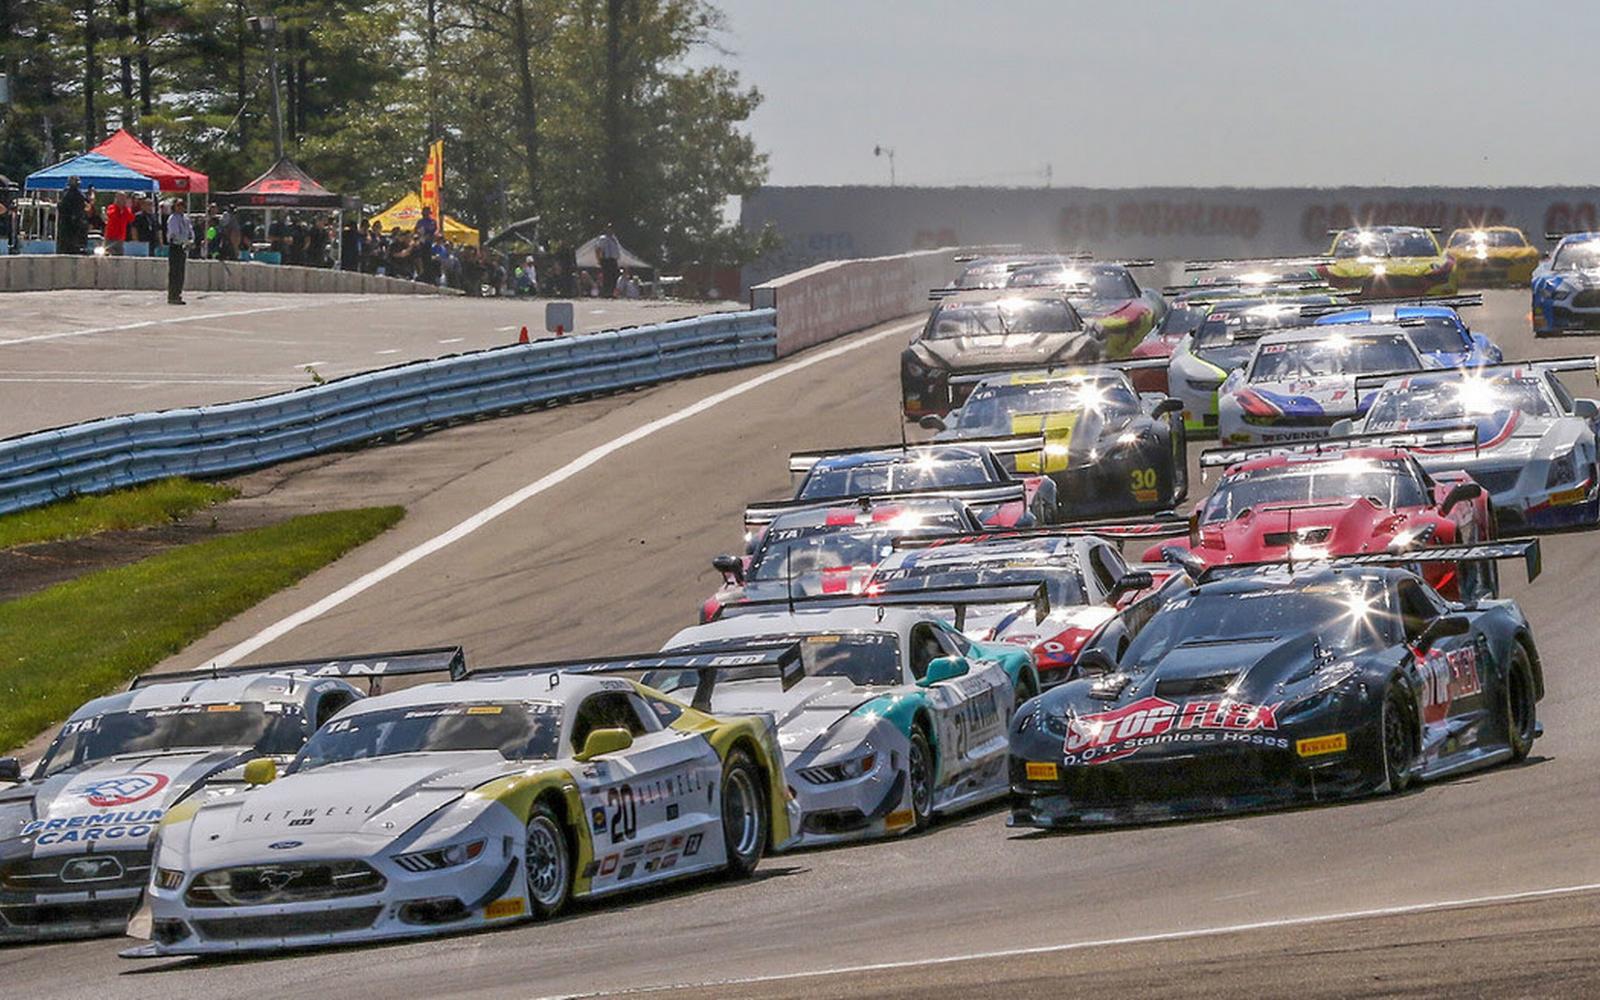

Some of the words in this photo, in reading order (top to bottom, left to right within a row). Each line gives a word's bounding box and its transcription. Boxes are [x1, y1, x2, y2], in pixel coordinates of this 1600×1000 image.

[1130, 468, 1157, 490] 30
[1066, 705, 1178, 750] STOP
[1177, 701, 1284, 730] FLEX
[1123, 731, 1216, 750] Stainless
[1222, 731, 1289, 749] Hoses
[1300, 735, 1346, 755] PIRELLI
[243, 806, 374, 824] ALTWELL
[607, 783, 637, 844] 20
[36, 826, 151, 845] CARGO
